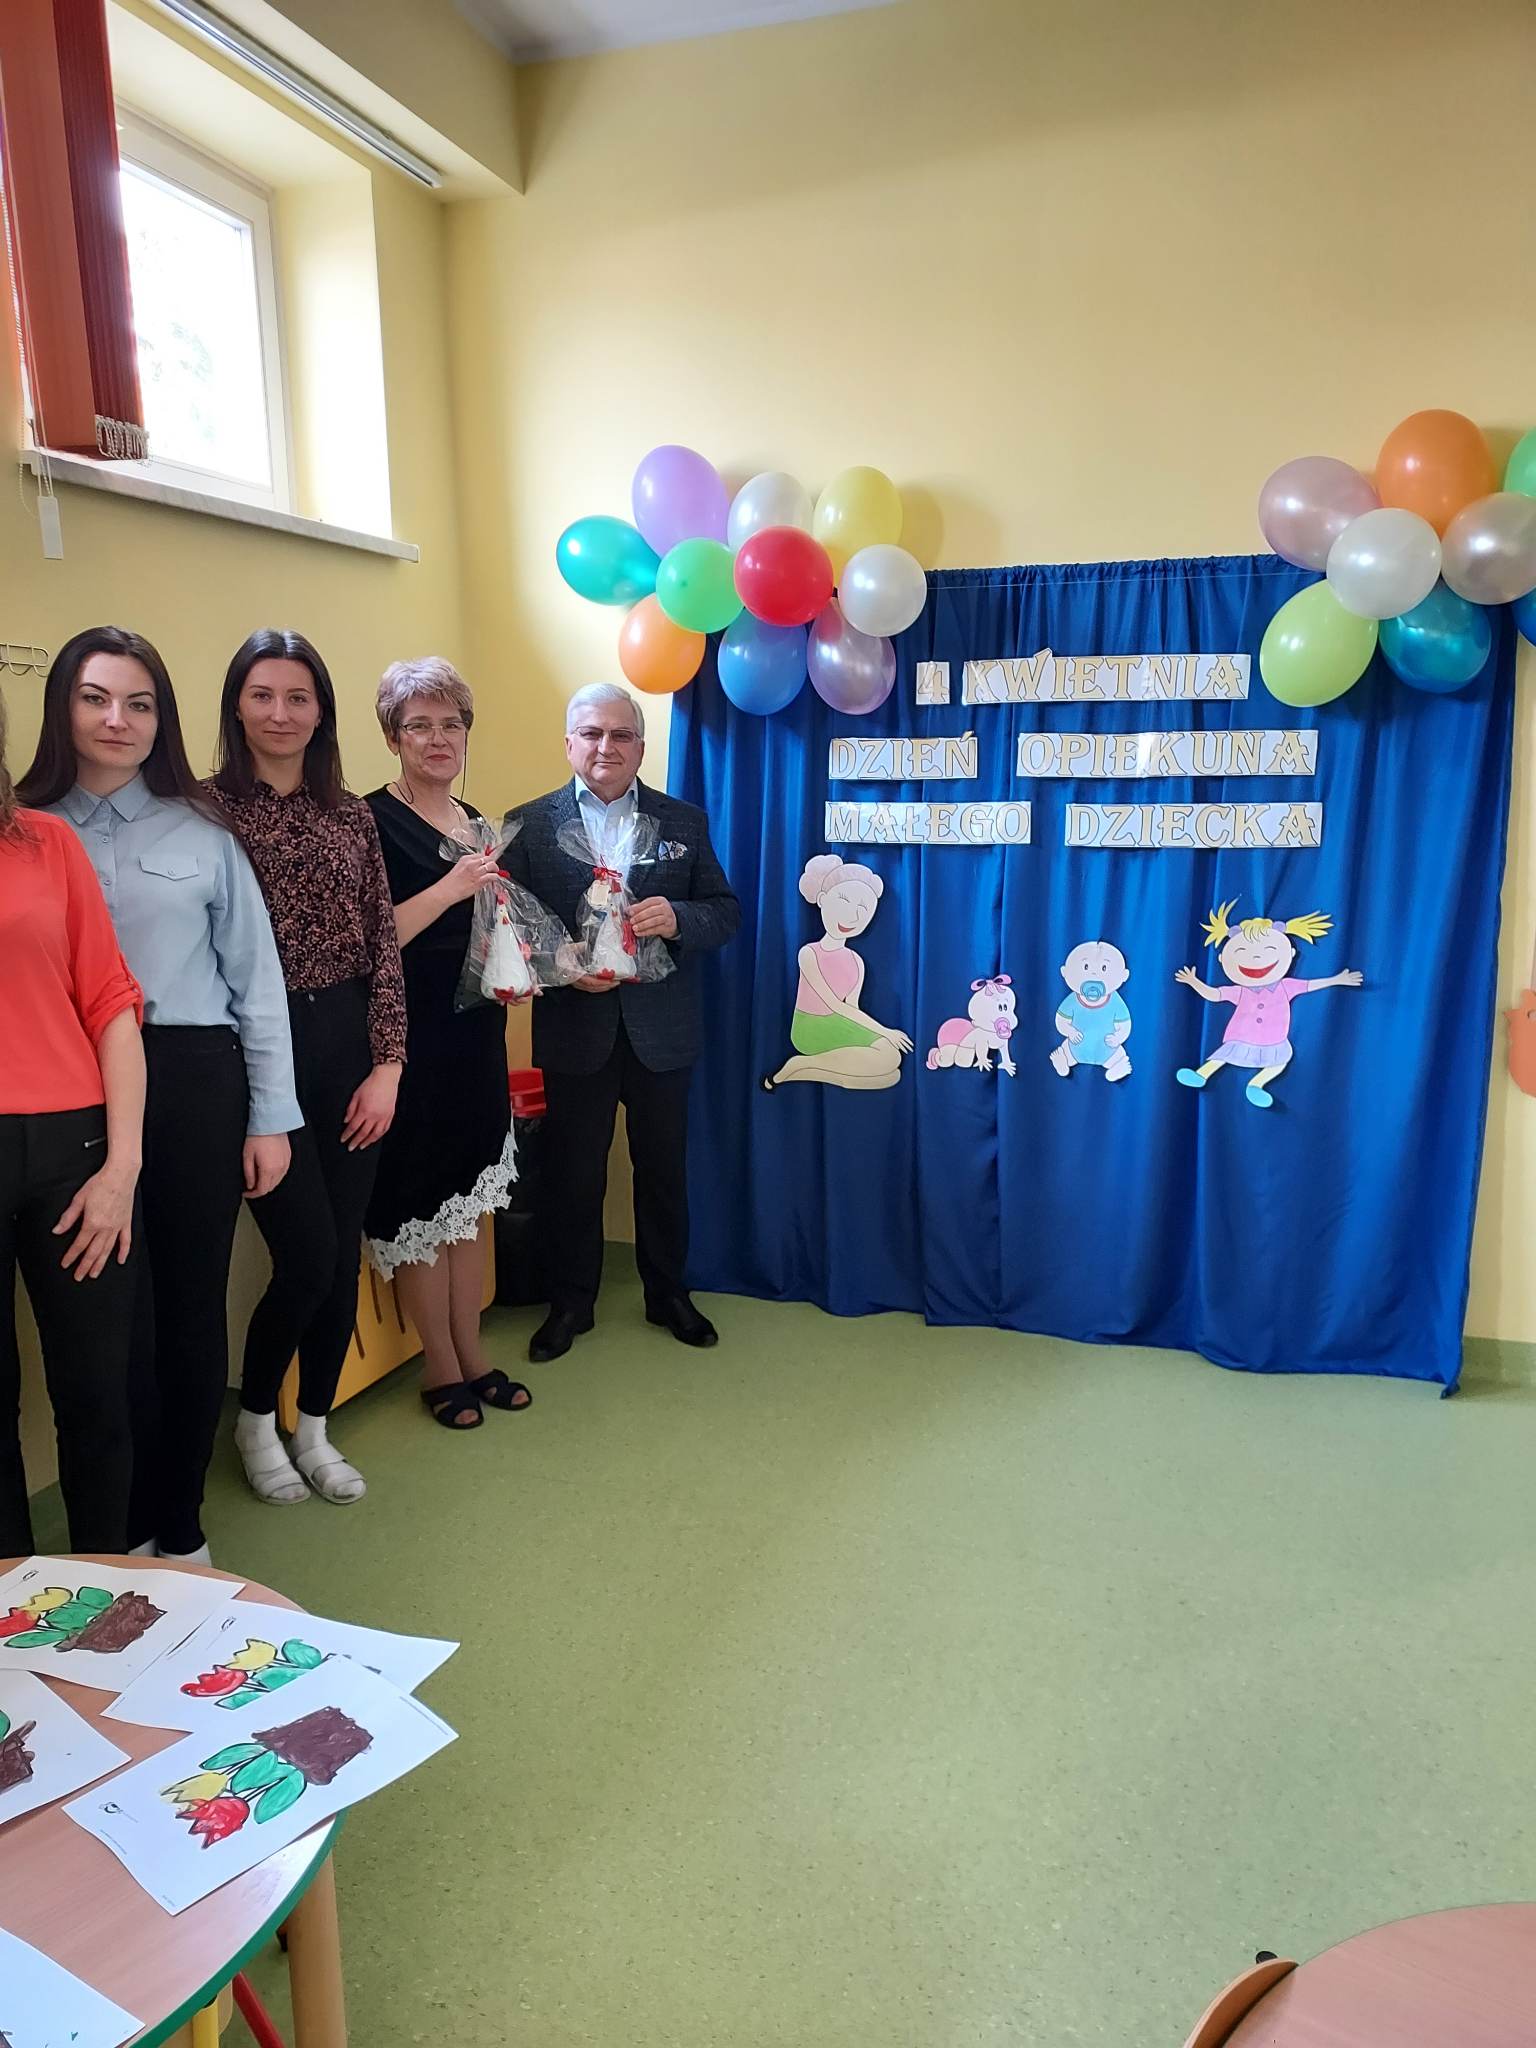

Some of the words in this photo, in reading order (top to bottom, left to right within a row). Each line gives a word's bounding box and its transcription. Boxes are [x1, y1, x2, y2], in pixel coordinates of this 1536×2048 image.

[918, 661, 949, 703] 4
[966, 650, 1246, 703] KWIETNIA
[830, 730, 977, 779] DZIEŃ
[1020, 731, 1313, 777] OPIEKUNA
[826, 802, 1030, 843] MAŁEGO
[1066, 804, 1319, 847] DZIECKA
